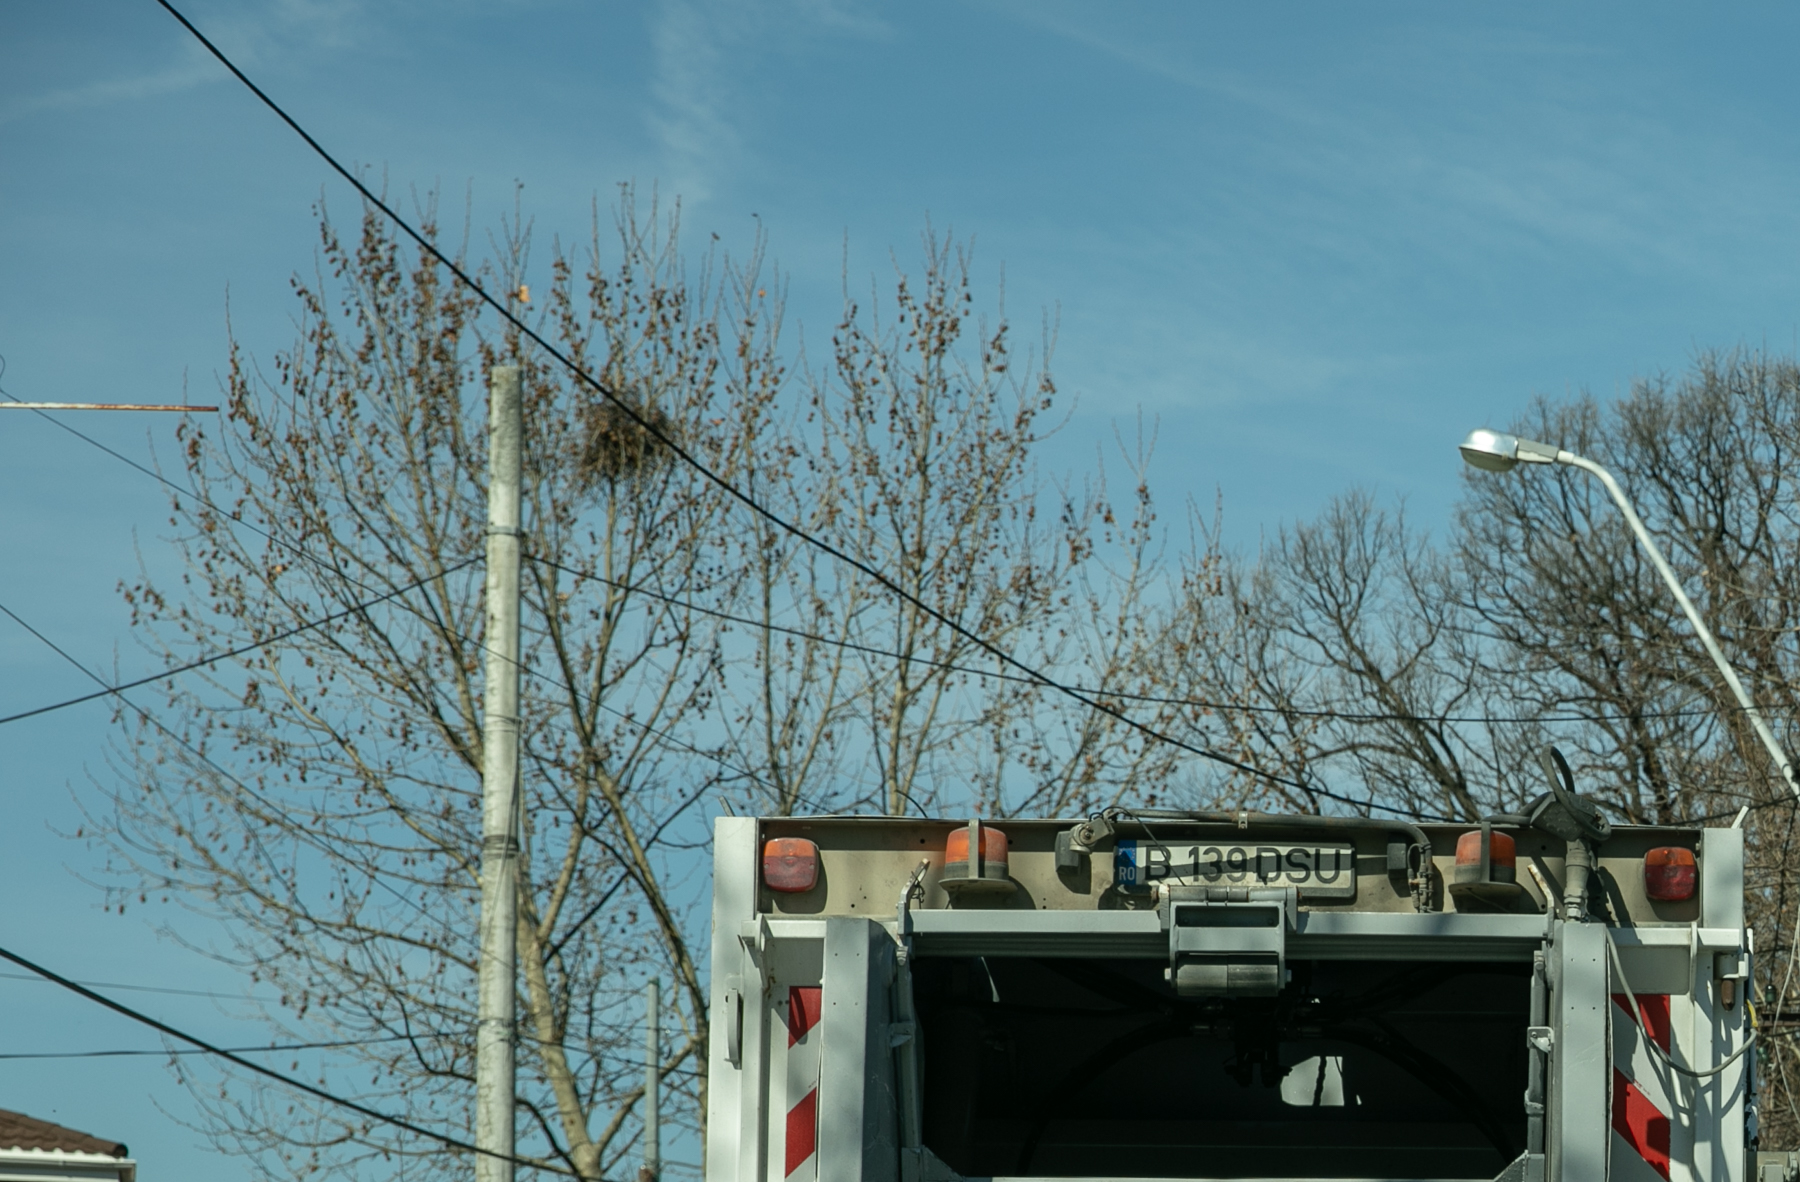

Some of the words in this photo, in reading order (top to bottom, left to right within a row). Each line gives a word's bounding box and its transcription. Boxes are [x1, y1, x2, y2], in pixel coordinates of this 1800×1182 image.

[1119, 866, 1136, 882] RO
[1145, 844, 1171, 881] B
[1188, 845, 1248, 883] 139
[1256, 847, 1341, 885] DSU
